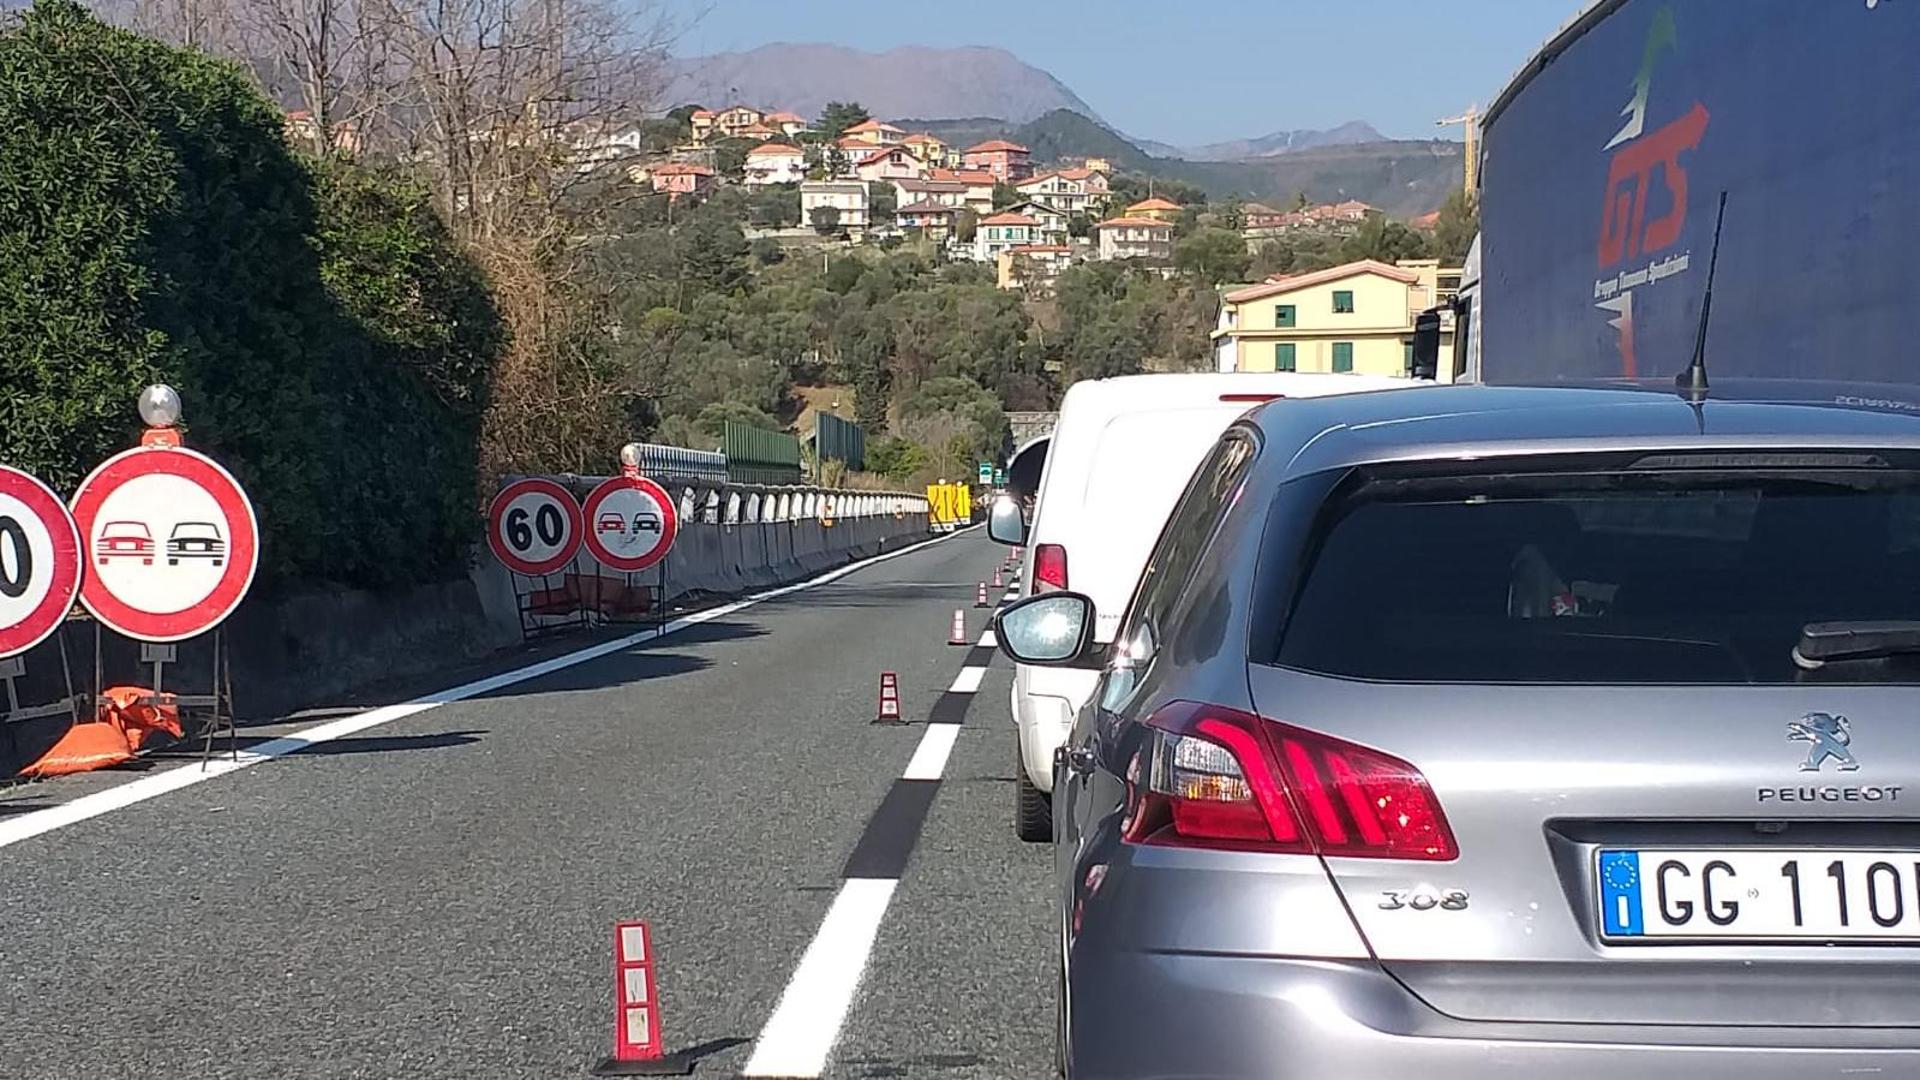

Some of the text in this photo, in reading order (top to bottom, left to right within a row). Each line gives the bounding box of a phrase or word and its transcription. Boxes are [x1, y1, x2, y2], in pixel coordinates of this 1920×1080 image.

[506, 503, 564, 551] 60
[1758, 787, 1903, 802] PEUGEOT
[1377, 889, 1470, 911] 308
[1656, 859, 1920, 928] GG 110
